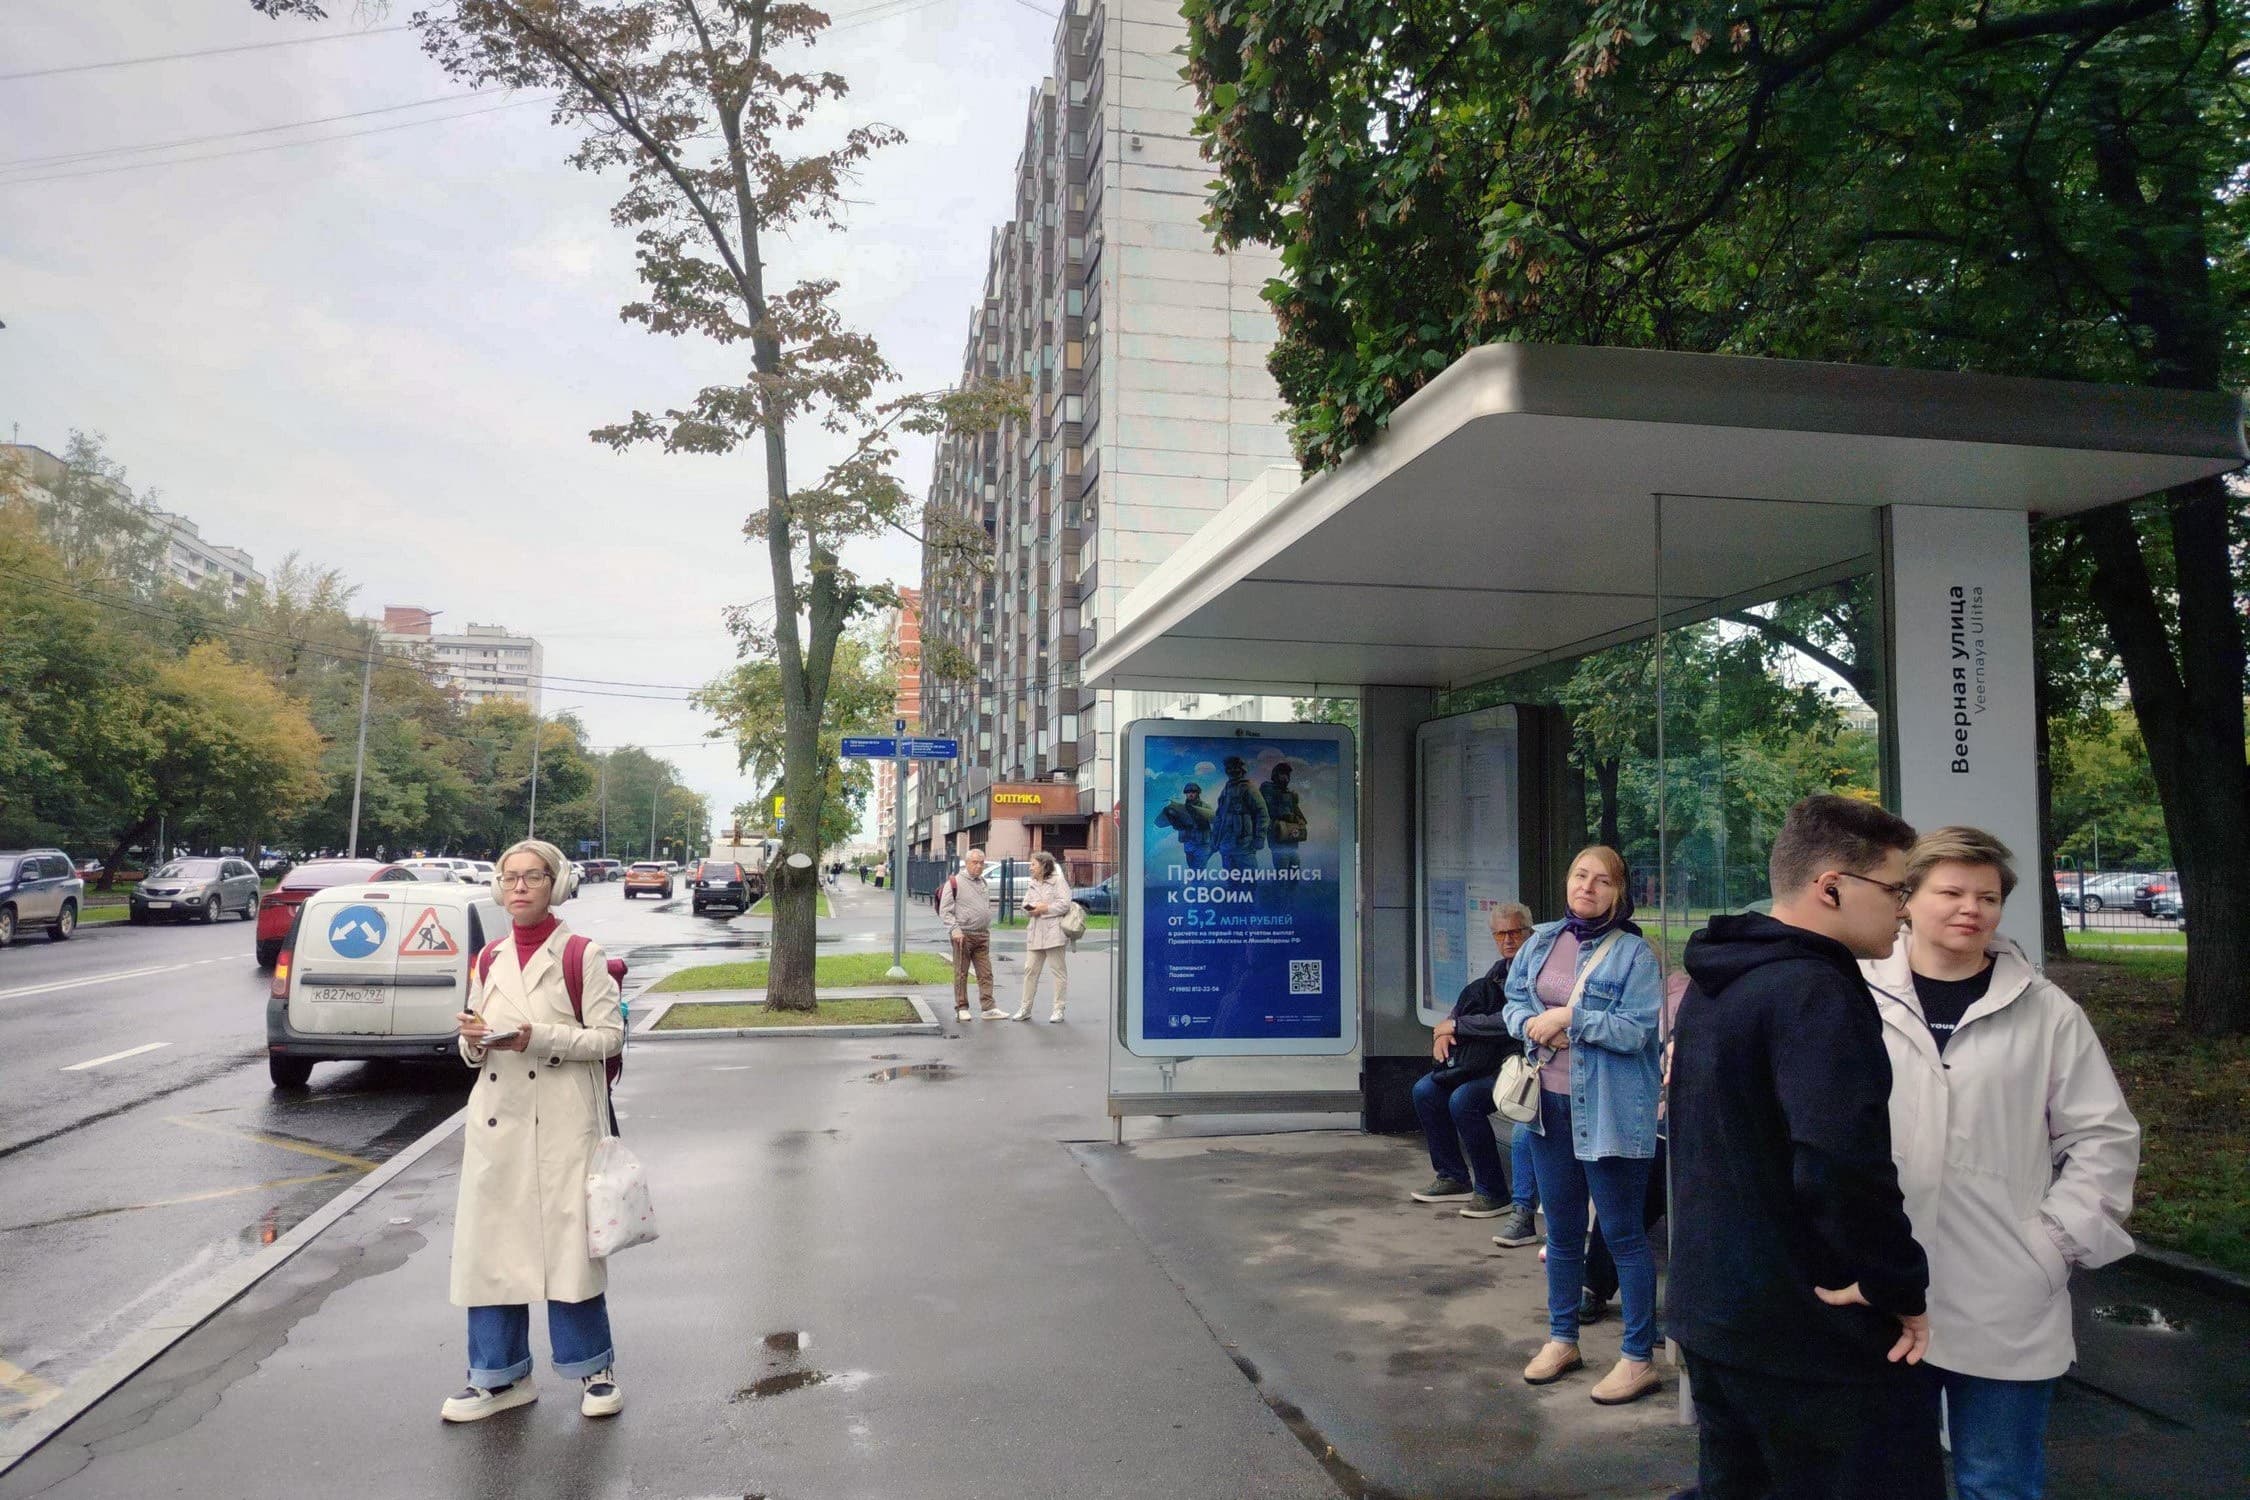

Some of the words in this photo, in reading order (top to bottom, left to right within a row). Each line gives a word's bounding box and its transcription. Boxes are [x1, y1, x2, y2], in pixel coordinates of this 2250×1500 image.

[1950, 585, 1970, 660] улица
[1971, 586, 1984, 633] Ulitsa
[1974, 638, 1988, 714] Veernaya
[1951, 667, 1972, 773] Веерная
[993, 793, 1041, 804] ОПТИКА
[1167, 864, 1322, 884] Присоединяйся
[1167, 890, 1178, 903] к
[1183, 886, 1254, 903] СВОим
[1167, 916, 1184, 926] от
[1187, 909, 1217, 928] 5,2
[1250, 914, 1293, 926] РУБЛЕЙ
